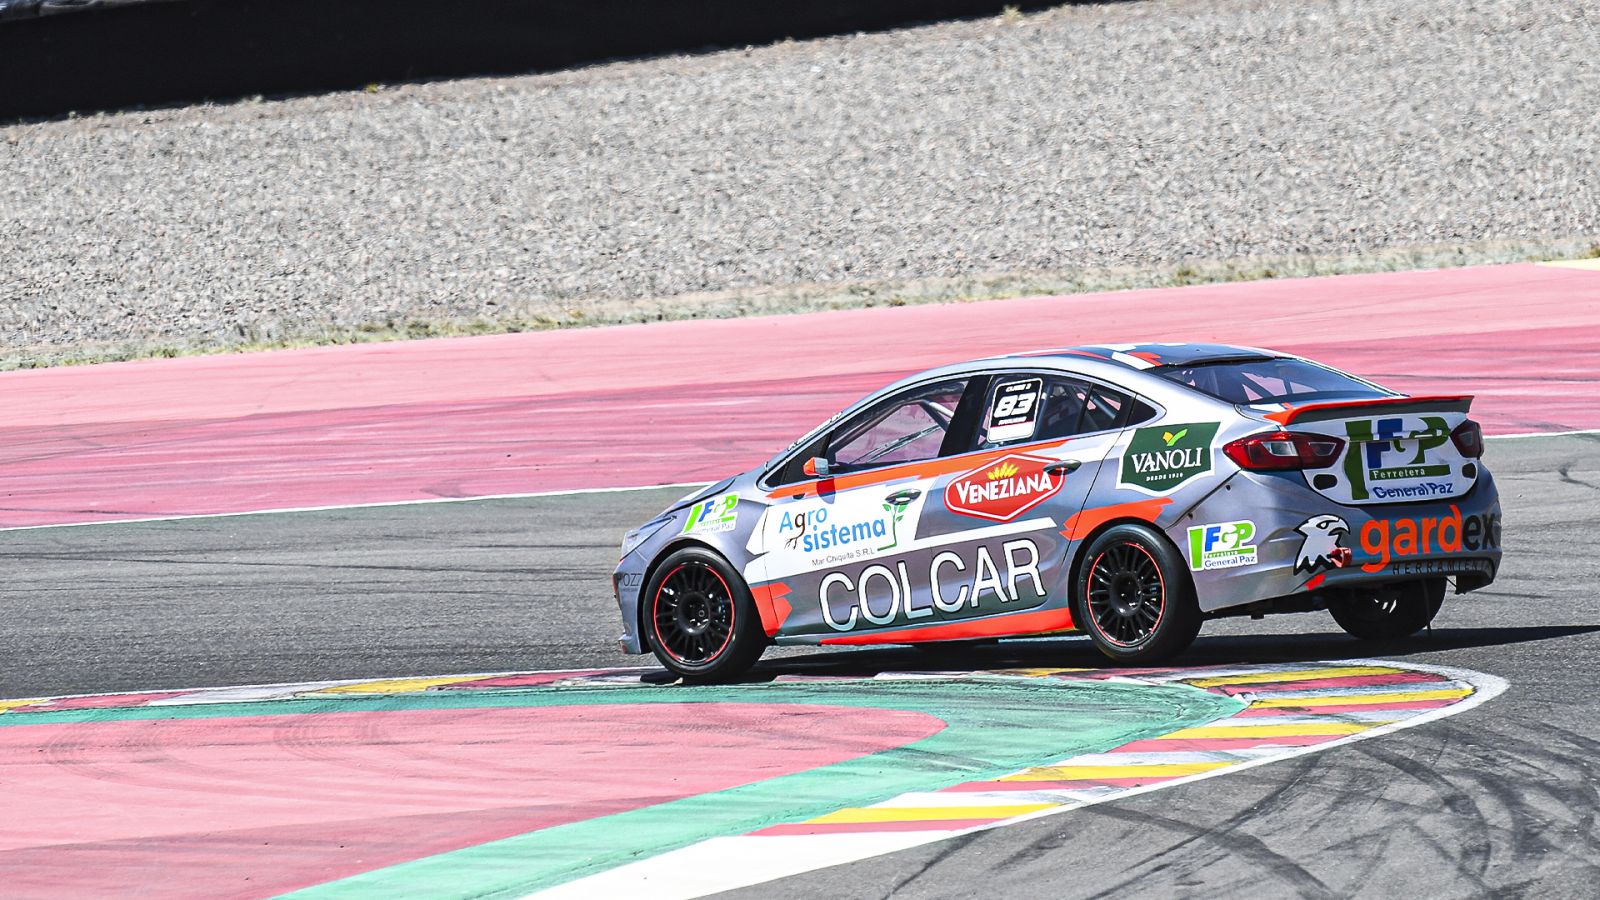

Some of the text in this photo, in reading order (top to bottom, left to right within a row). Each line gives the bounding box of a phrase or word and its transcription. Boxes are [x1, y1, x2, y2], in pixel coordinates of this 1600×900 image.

[994, 392, 1036, 418] 83
[1131, 447, 1203, 473] VANOLI
[1372, 469, 1426, 479] Ferretera
[956, 472, 1054, 505] VENEZIANA
[1373, 482, 1454, 499] General Paz
[779, 508, 827, 550] Agro
[803, 519, 886, 552] sistema
[1360, 504, 1497, 573] gardex
[1205, 555, 1256, 567] General Paz
[819, 538, 1047, 632] COLCAR
